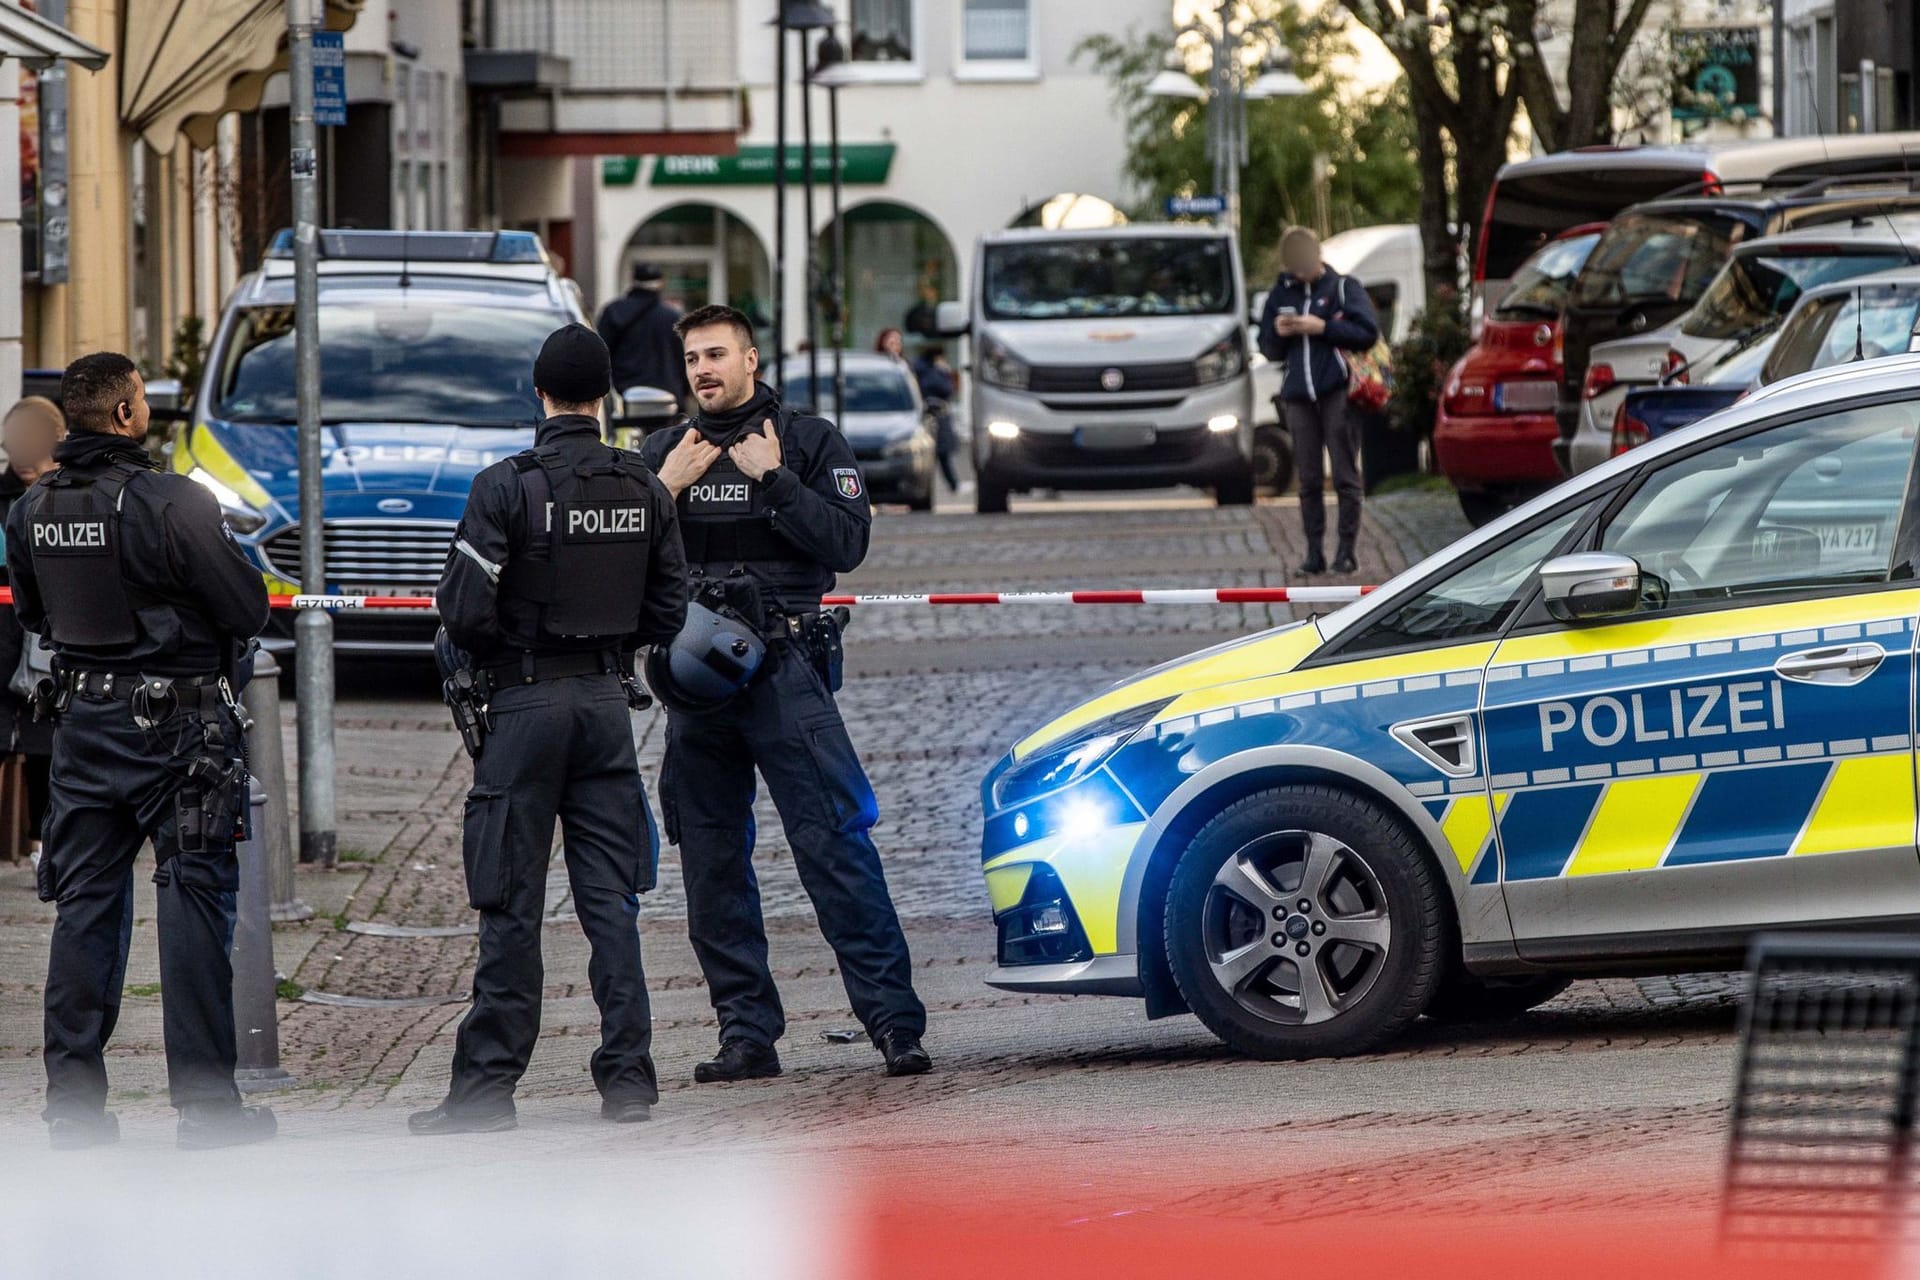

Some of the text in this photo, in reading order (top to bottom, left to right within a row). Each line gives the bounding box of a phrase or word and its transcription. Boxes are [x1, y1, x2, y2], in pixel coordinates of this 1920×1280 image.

[689, 484, 749, 503] POLIZEI
[568, 507, 646, 534] POLIZEI
[33, 522, 106, 547] POLIZEI
[1844, 526, 1874, 548] 717
[1538, 680, 1785, 752] POLIZEI
